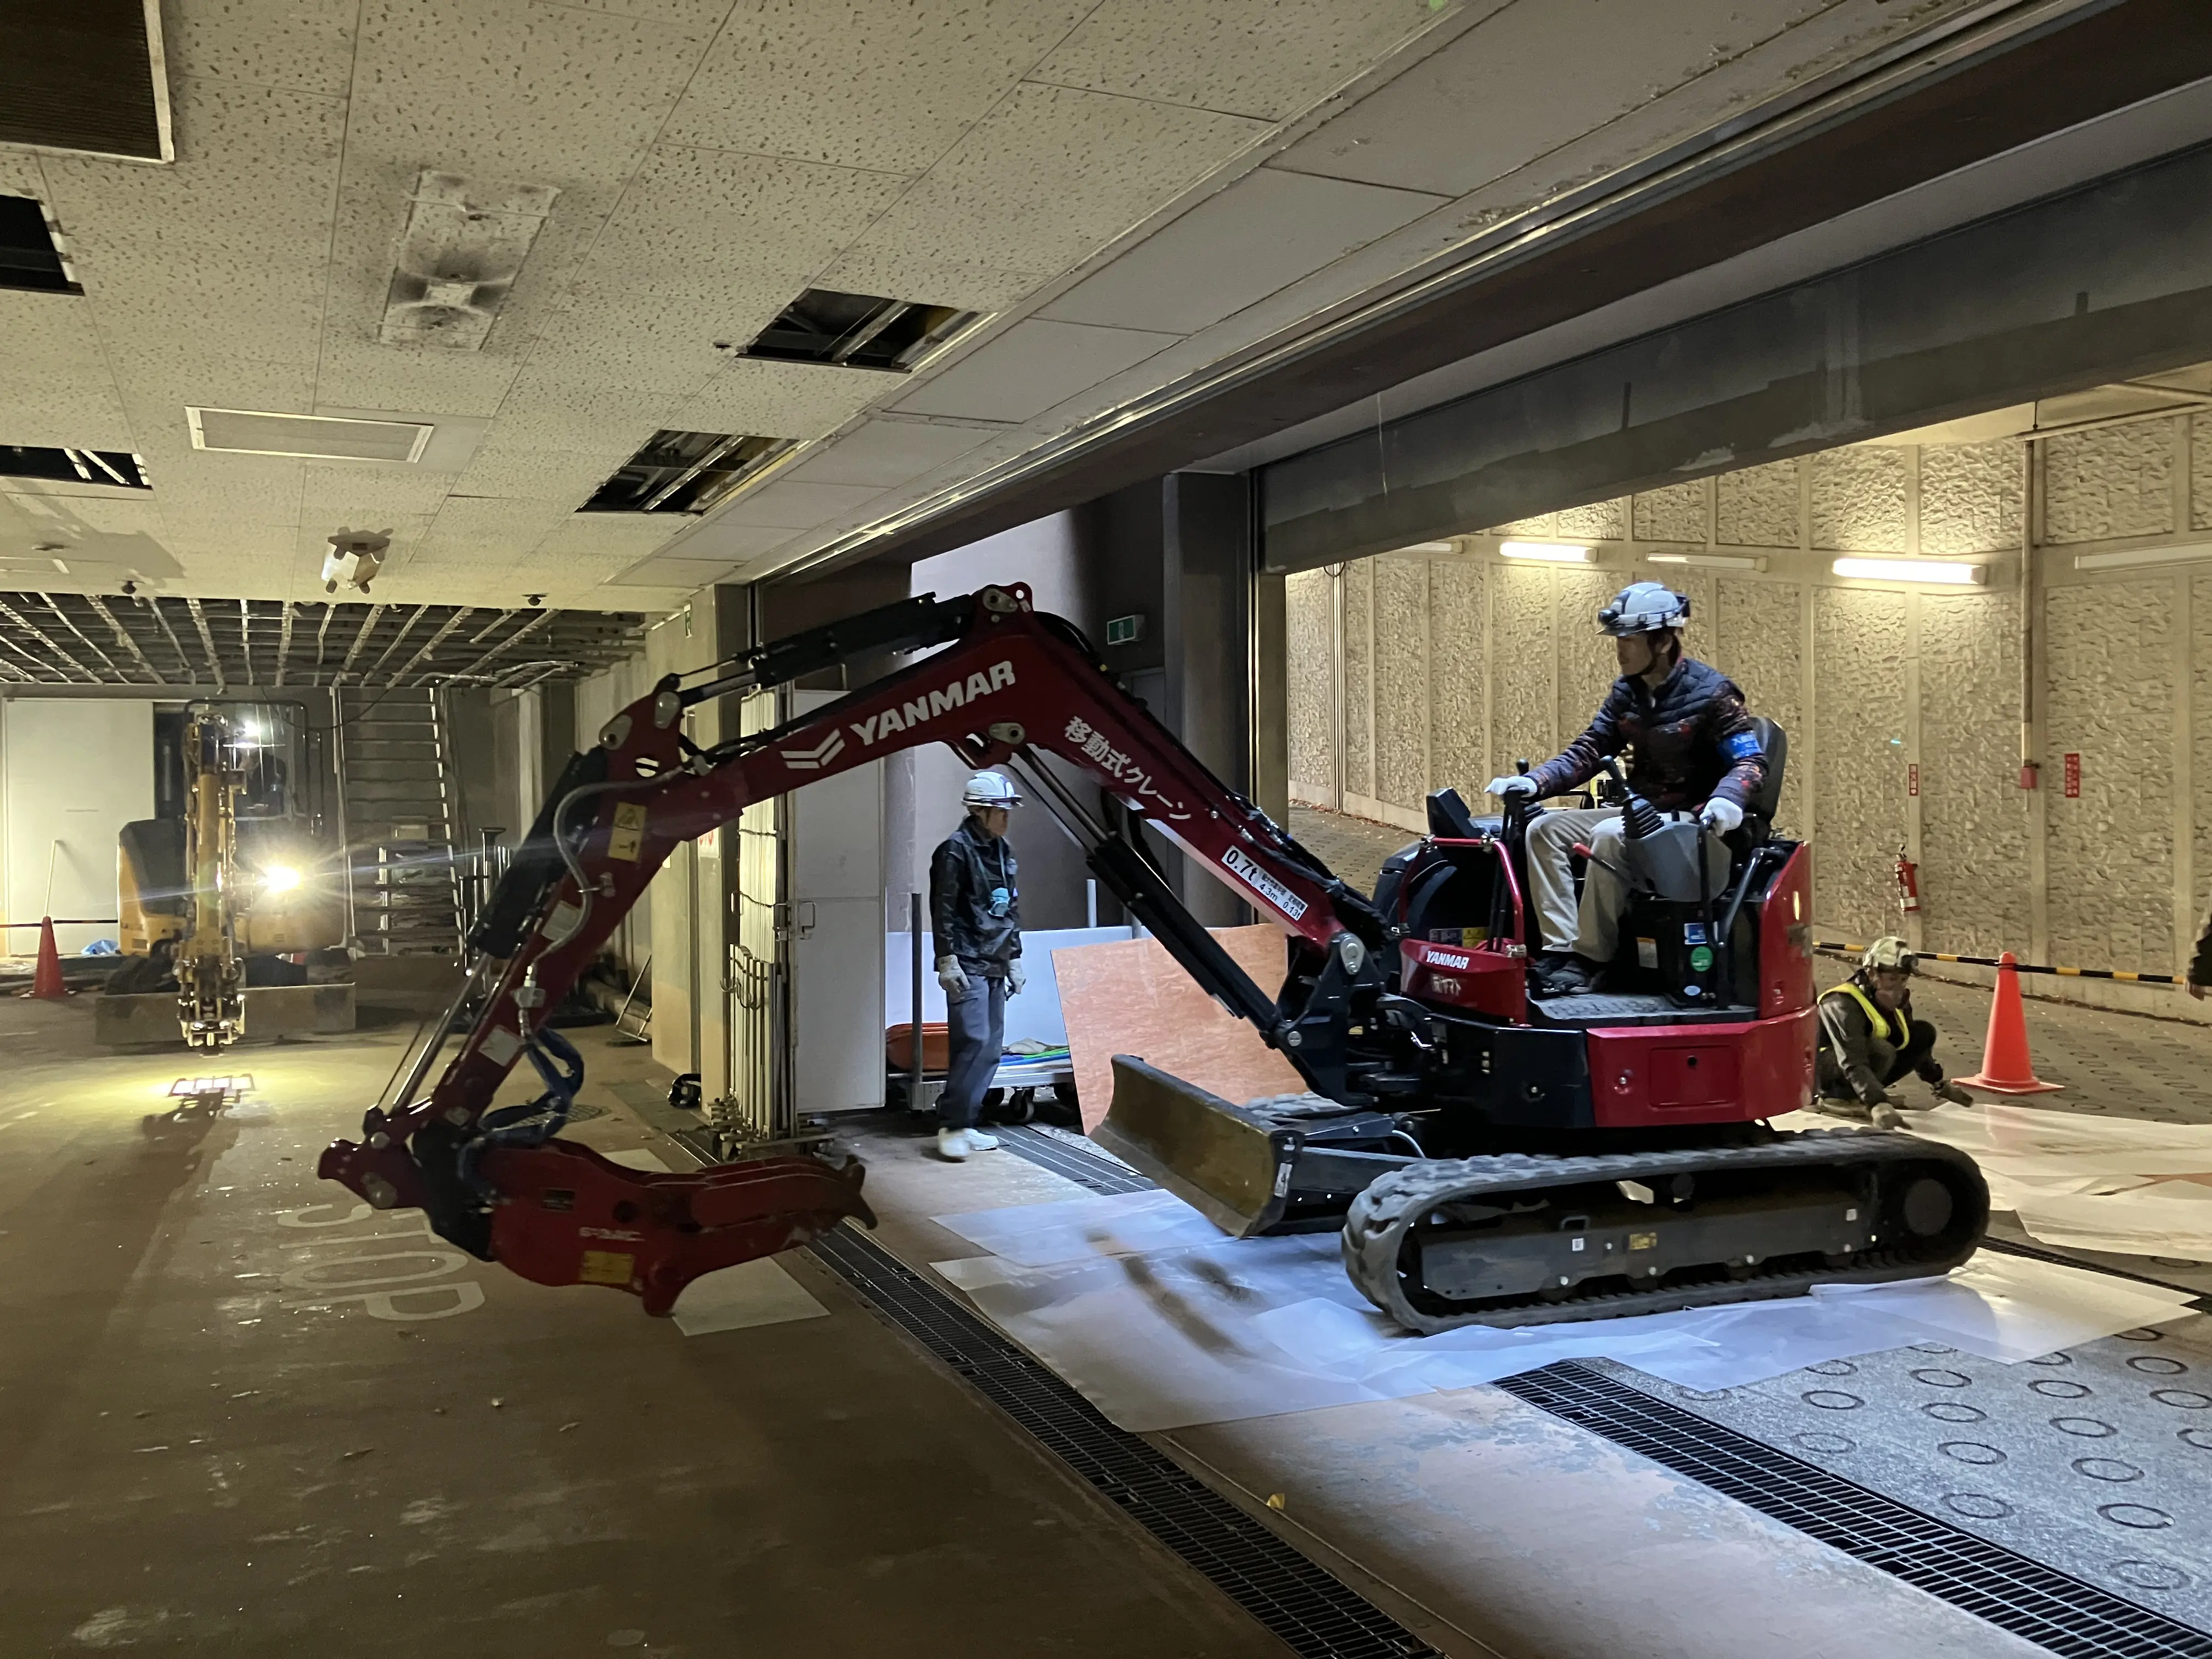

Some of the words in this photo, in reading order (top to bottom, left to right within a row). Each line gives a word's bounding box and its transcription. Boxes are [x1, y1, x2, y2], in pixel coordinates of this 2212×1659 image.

[849, 661, 1015, 746] YANMAR
[1065, 715, 1191, 820] 移動式クレーン
[1227, 850, 1257, 881] 0.7t
[1259, 883, 1278, 901] 4.3m
[1282, 901, 1301, 919] 0.13t
[1426, 950, 1469, 969] YANMAR
